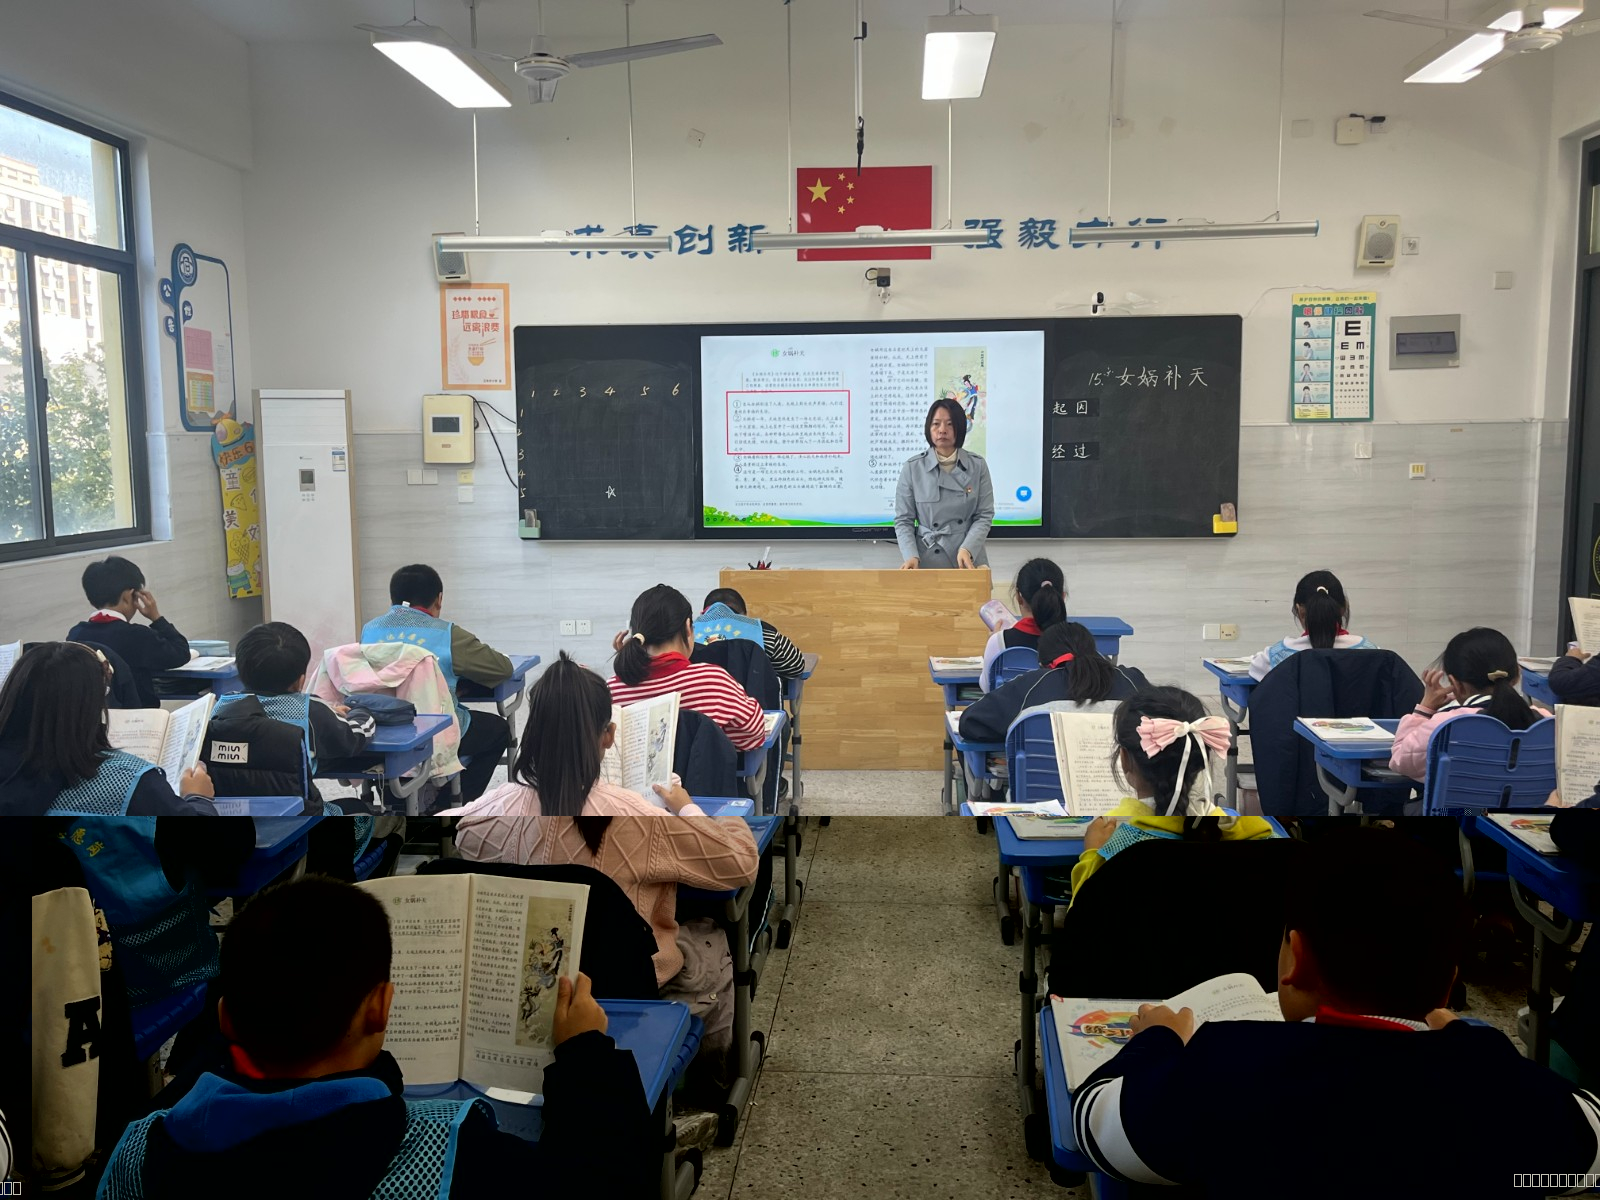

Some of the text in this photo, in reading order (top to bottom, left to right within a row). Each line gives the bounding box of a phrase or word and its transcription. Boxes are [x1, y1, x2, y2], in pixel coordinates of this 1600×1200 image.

[1115, 364, 1208, 391] 女娲补天
[553, 389, 561, 397] 2
[579, 387, 587, 397] 3
[604, 387, 616, 397] 4
[640, 386, 650, 397] 5
[671, 383, 680, 396] 6
[1052, 400, 1088, 415] 起因
[1051, 443, 1091, 459] 经过
[61, 995, 101, 1068] A
